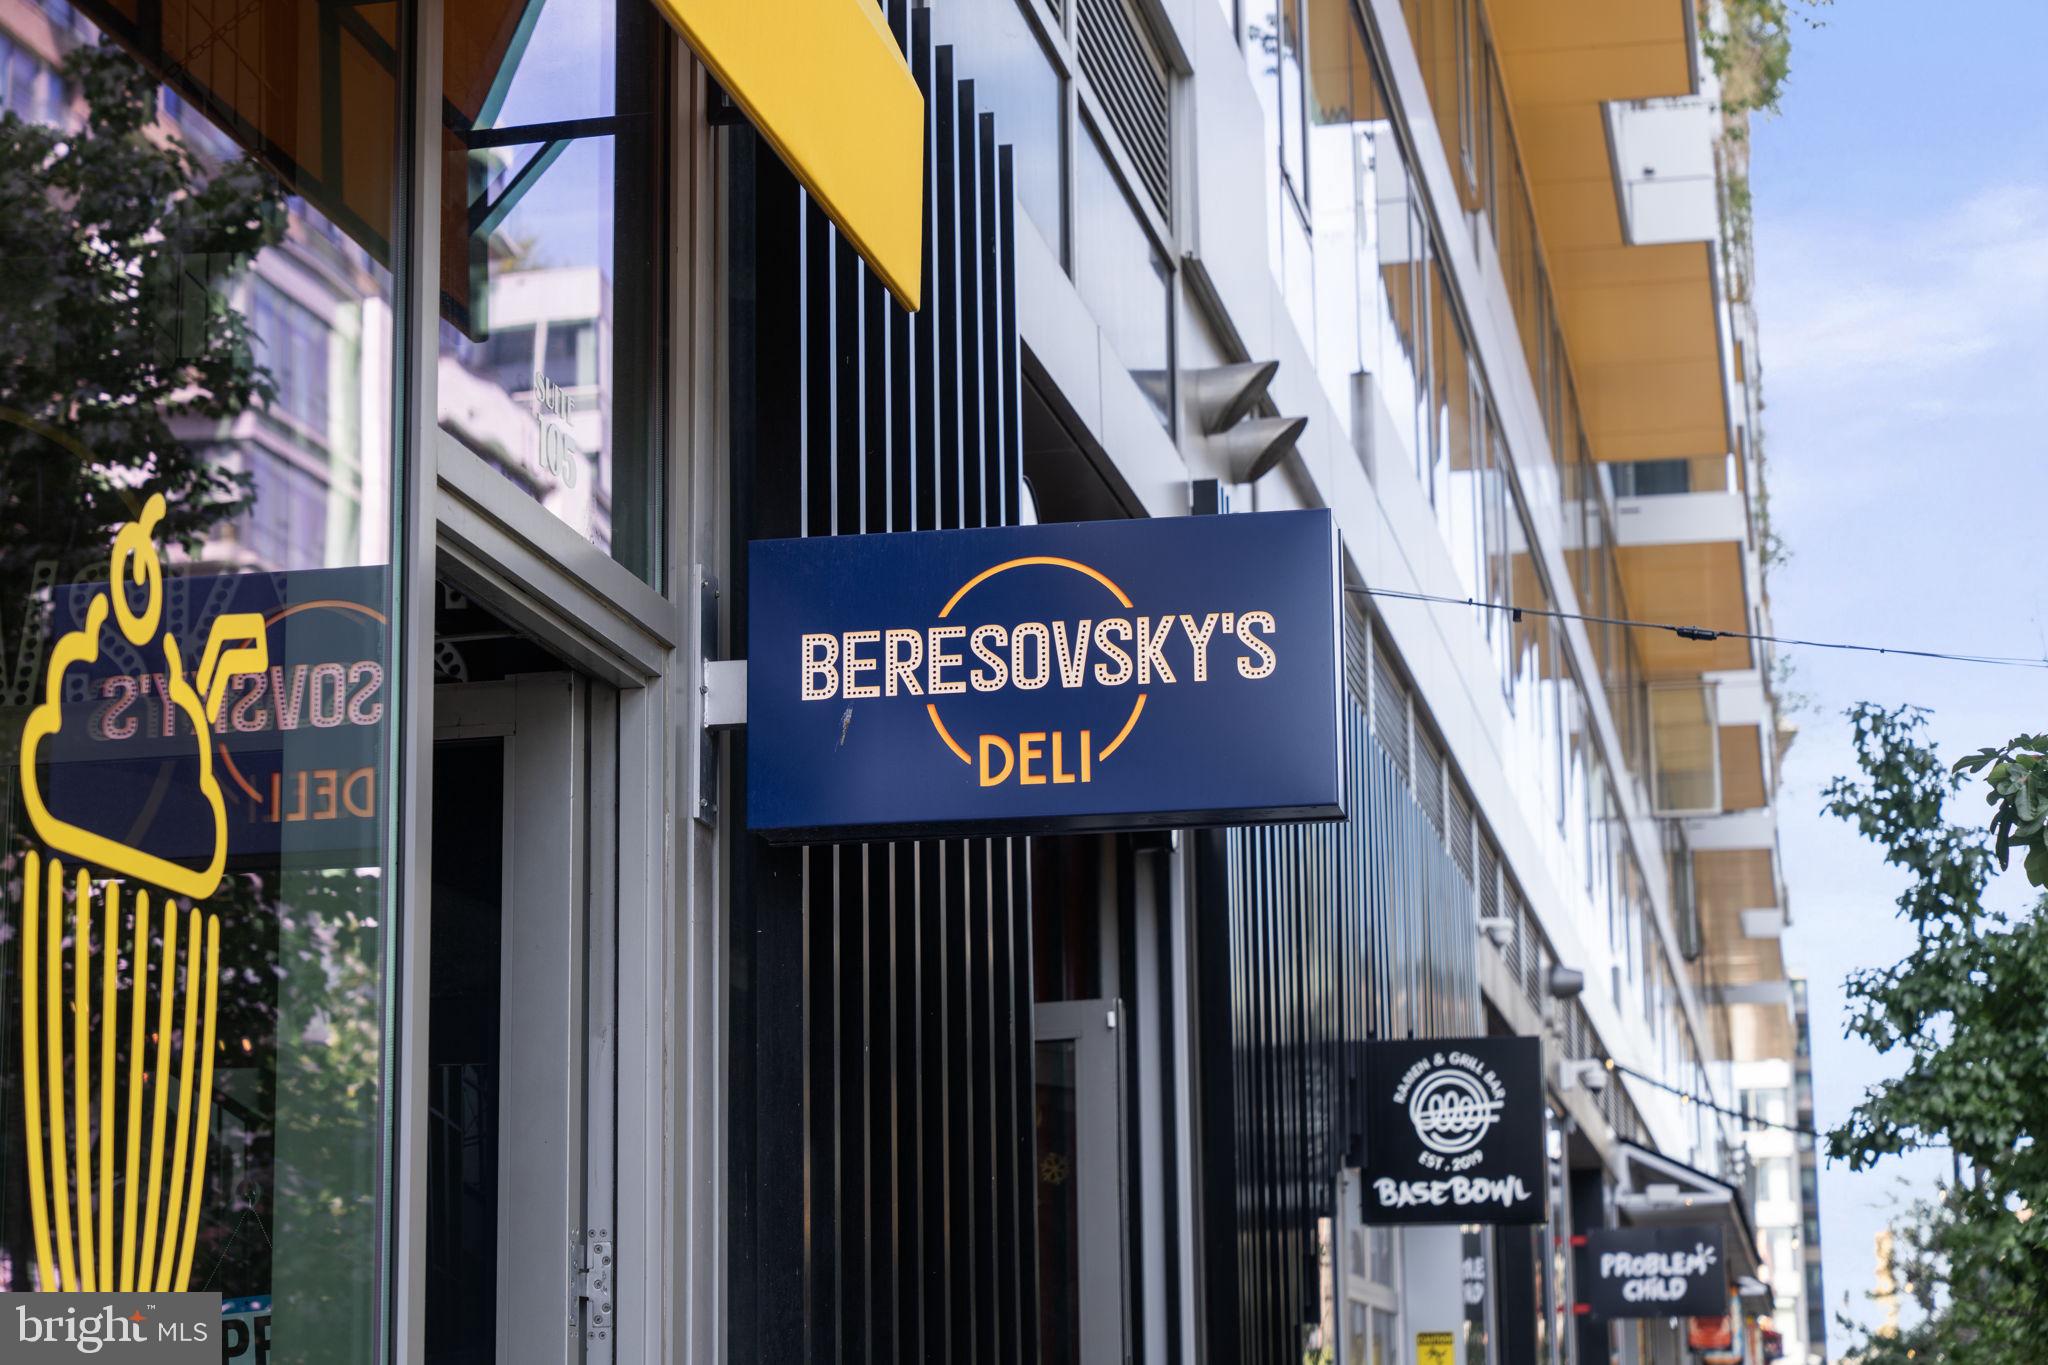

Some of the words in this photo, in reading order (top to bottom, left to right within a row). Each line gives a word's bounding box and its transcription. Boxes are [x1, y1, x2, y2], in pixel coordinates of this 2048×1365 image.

[535, 371, 576, 427] SUITE
[537, 413, 577, 489] 105
[801, 610, 1277, 701] BERESOVSKY'S
[979, 730, 1092, 787] DELI
[1393, 1057, 1431, 1104] RAMEN
[1433, 1052, 1446, 1067] &
[1449, 1051, 1485, 1076] GRILL
[1483, 1070, 1507, 1100] BAR
[1451, 1149, 1484, 1172] 2019
[1600, 1251, 1709, 1278] PROBLEM
